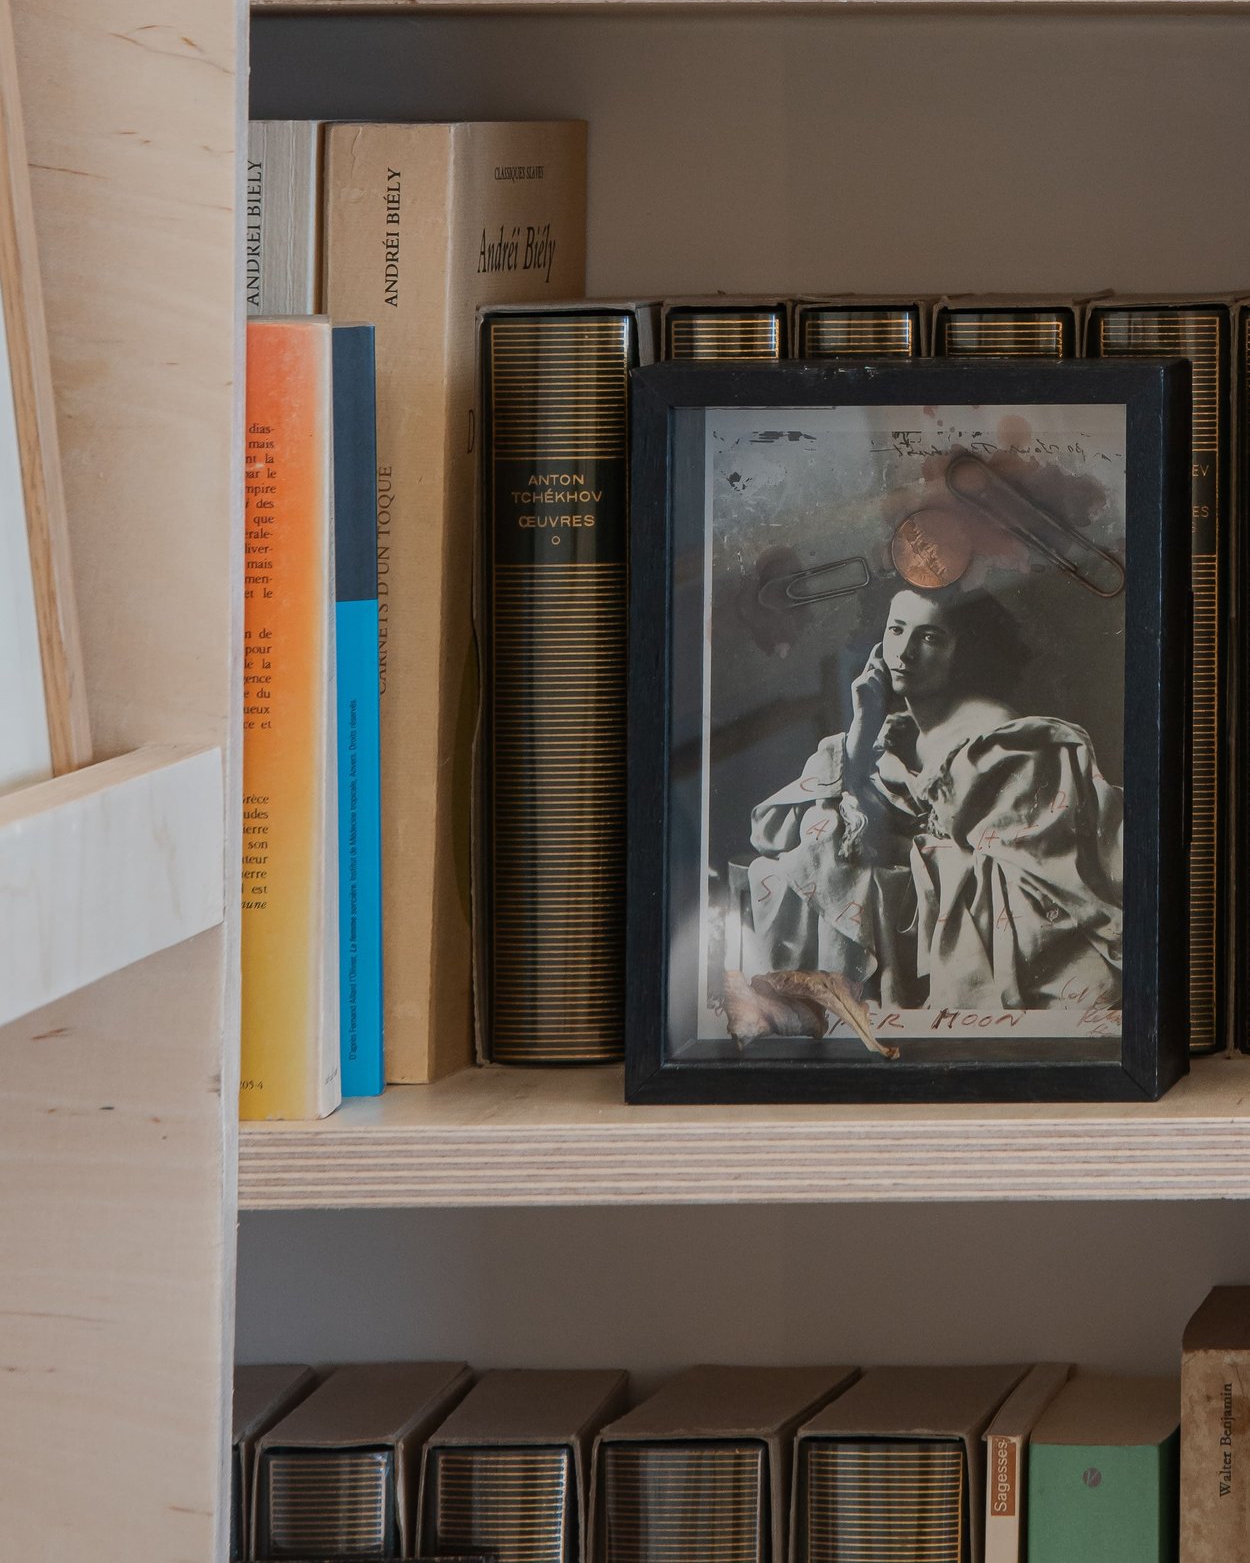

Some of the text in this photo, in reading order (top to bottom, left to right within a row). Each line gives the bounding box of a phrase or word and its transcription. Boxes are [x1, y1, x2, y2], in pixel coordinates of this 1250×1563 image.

[382, 167, 401, 307] ANDRÉI BIÉLY
[477, 223, 556, 283] Andréi Biély
[511, 488, 602, 503] TCHÉKHOV
[528, 474, 585, 486] ANTON
[518, 515, 596, 528] ŒUVRES
[1219, 1382, 1234, 1498] Walter Benjamin
[994, 1439, 1009, 1513] Sagesses
